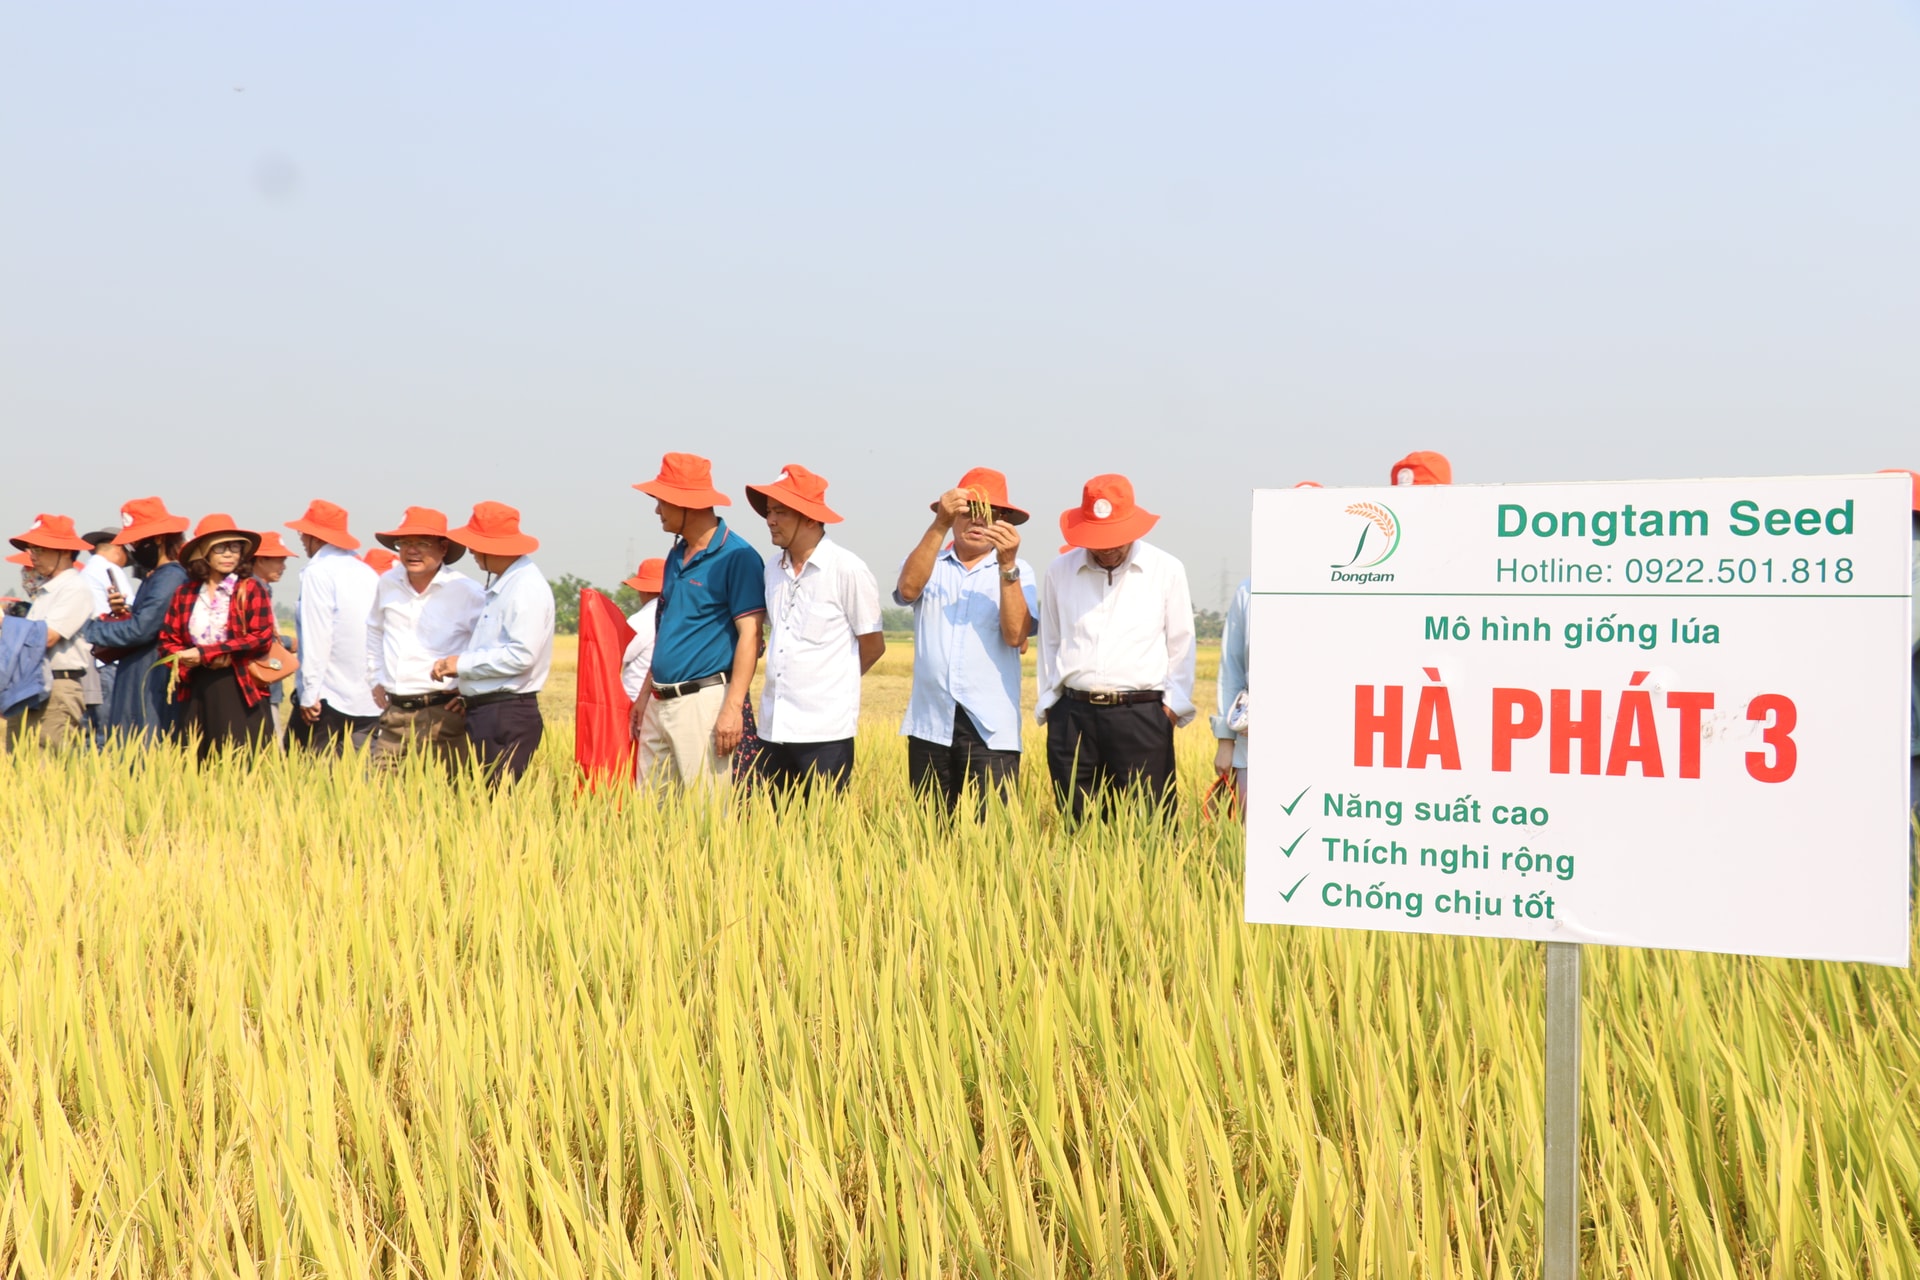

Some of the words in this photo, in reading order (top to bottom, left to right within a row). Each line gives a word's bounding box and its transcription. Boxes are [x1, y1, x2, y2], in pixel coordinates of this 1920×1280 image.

[1497, 504, 1709, 547] Dongtam
[1729, 499, 1854, 537] Seed
[1331, 570, 1395, 585] Dongtam
[1496, 558, 1613, 583] Hotline:
[1625, 557, 1854, 584] 0922.501.818
[1425, 615, 1471, 641] Mô
[1482, 615, 1551, 641] hình
[1564, 613, 1658, 650] giống
[1672, 616, 1720, 644] lúa
[1353, 667, 1463, 771] HÀ
[1490, 671, 1716, 780] PHÁT
[1744, 693, 1799, 785] 3
[1324, 792, 1403, 826] Năng
[1415, 795, 1480, 823] suất
[1492, 806, 1550, 826] cao
[1321, 837, 1407, 866] Thích
[1421, 844, 1490, 874] nghi
[1502, 847, 1575, 881] rộng
[1321, 881, 1423, 918] Chống
[1435, 889, 1502, 921] chịu
[1513, 890, 1556, 919] tốt
